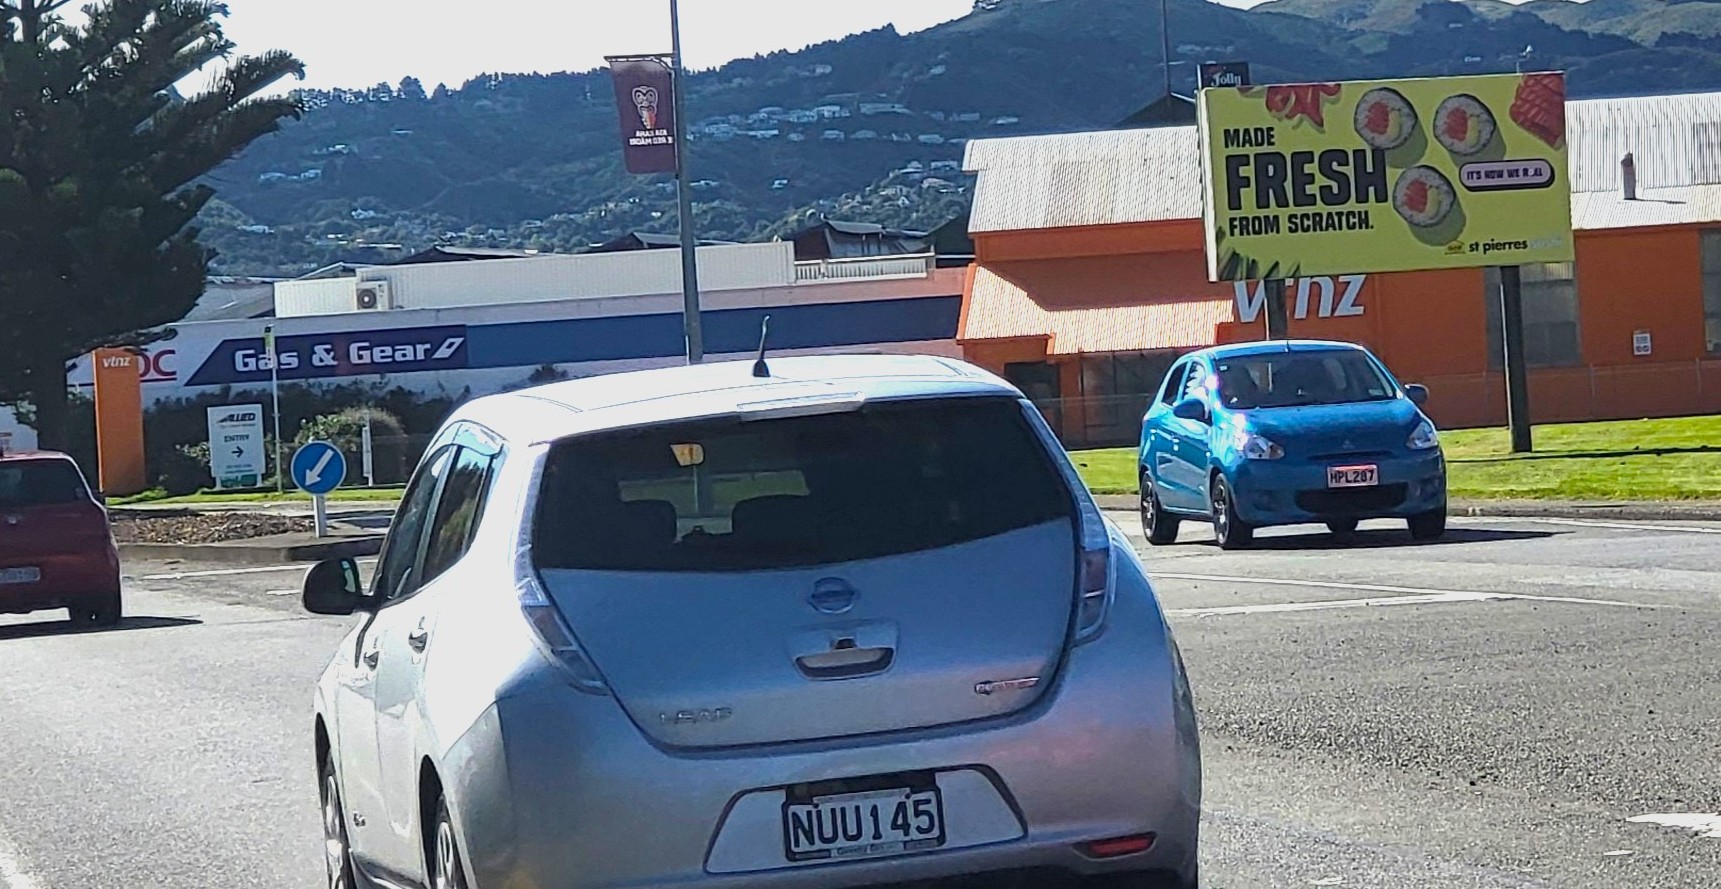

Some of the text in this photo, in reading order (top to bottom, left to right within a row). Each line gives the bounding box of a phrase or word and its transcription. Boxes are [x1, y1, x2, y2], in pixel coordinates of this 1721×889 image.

[1210, 72, 1241, 87] Jolly
[1223, 127, 1275, 148] MADE
[1225, 149, 1389, 211] FRESH
[1467, 170, 1482, 181] IT'S
[1507, 168, 1520, 178] WE
[1228, 210, 1374, 237] FROM SCRATCH.
[1469, 241, 1479, 253] st
[1482, 238, 1528, 255] pierres
[1233, 274, 1367, 324] vnz
[234, 349, 299, 372] Gas
[311, 344, 338, 367] &
[349, 341, 431, 365] Gear
[791, 798, 936, 851] NUU145
